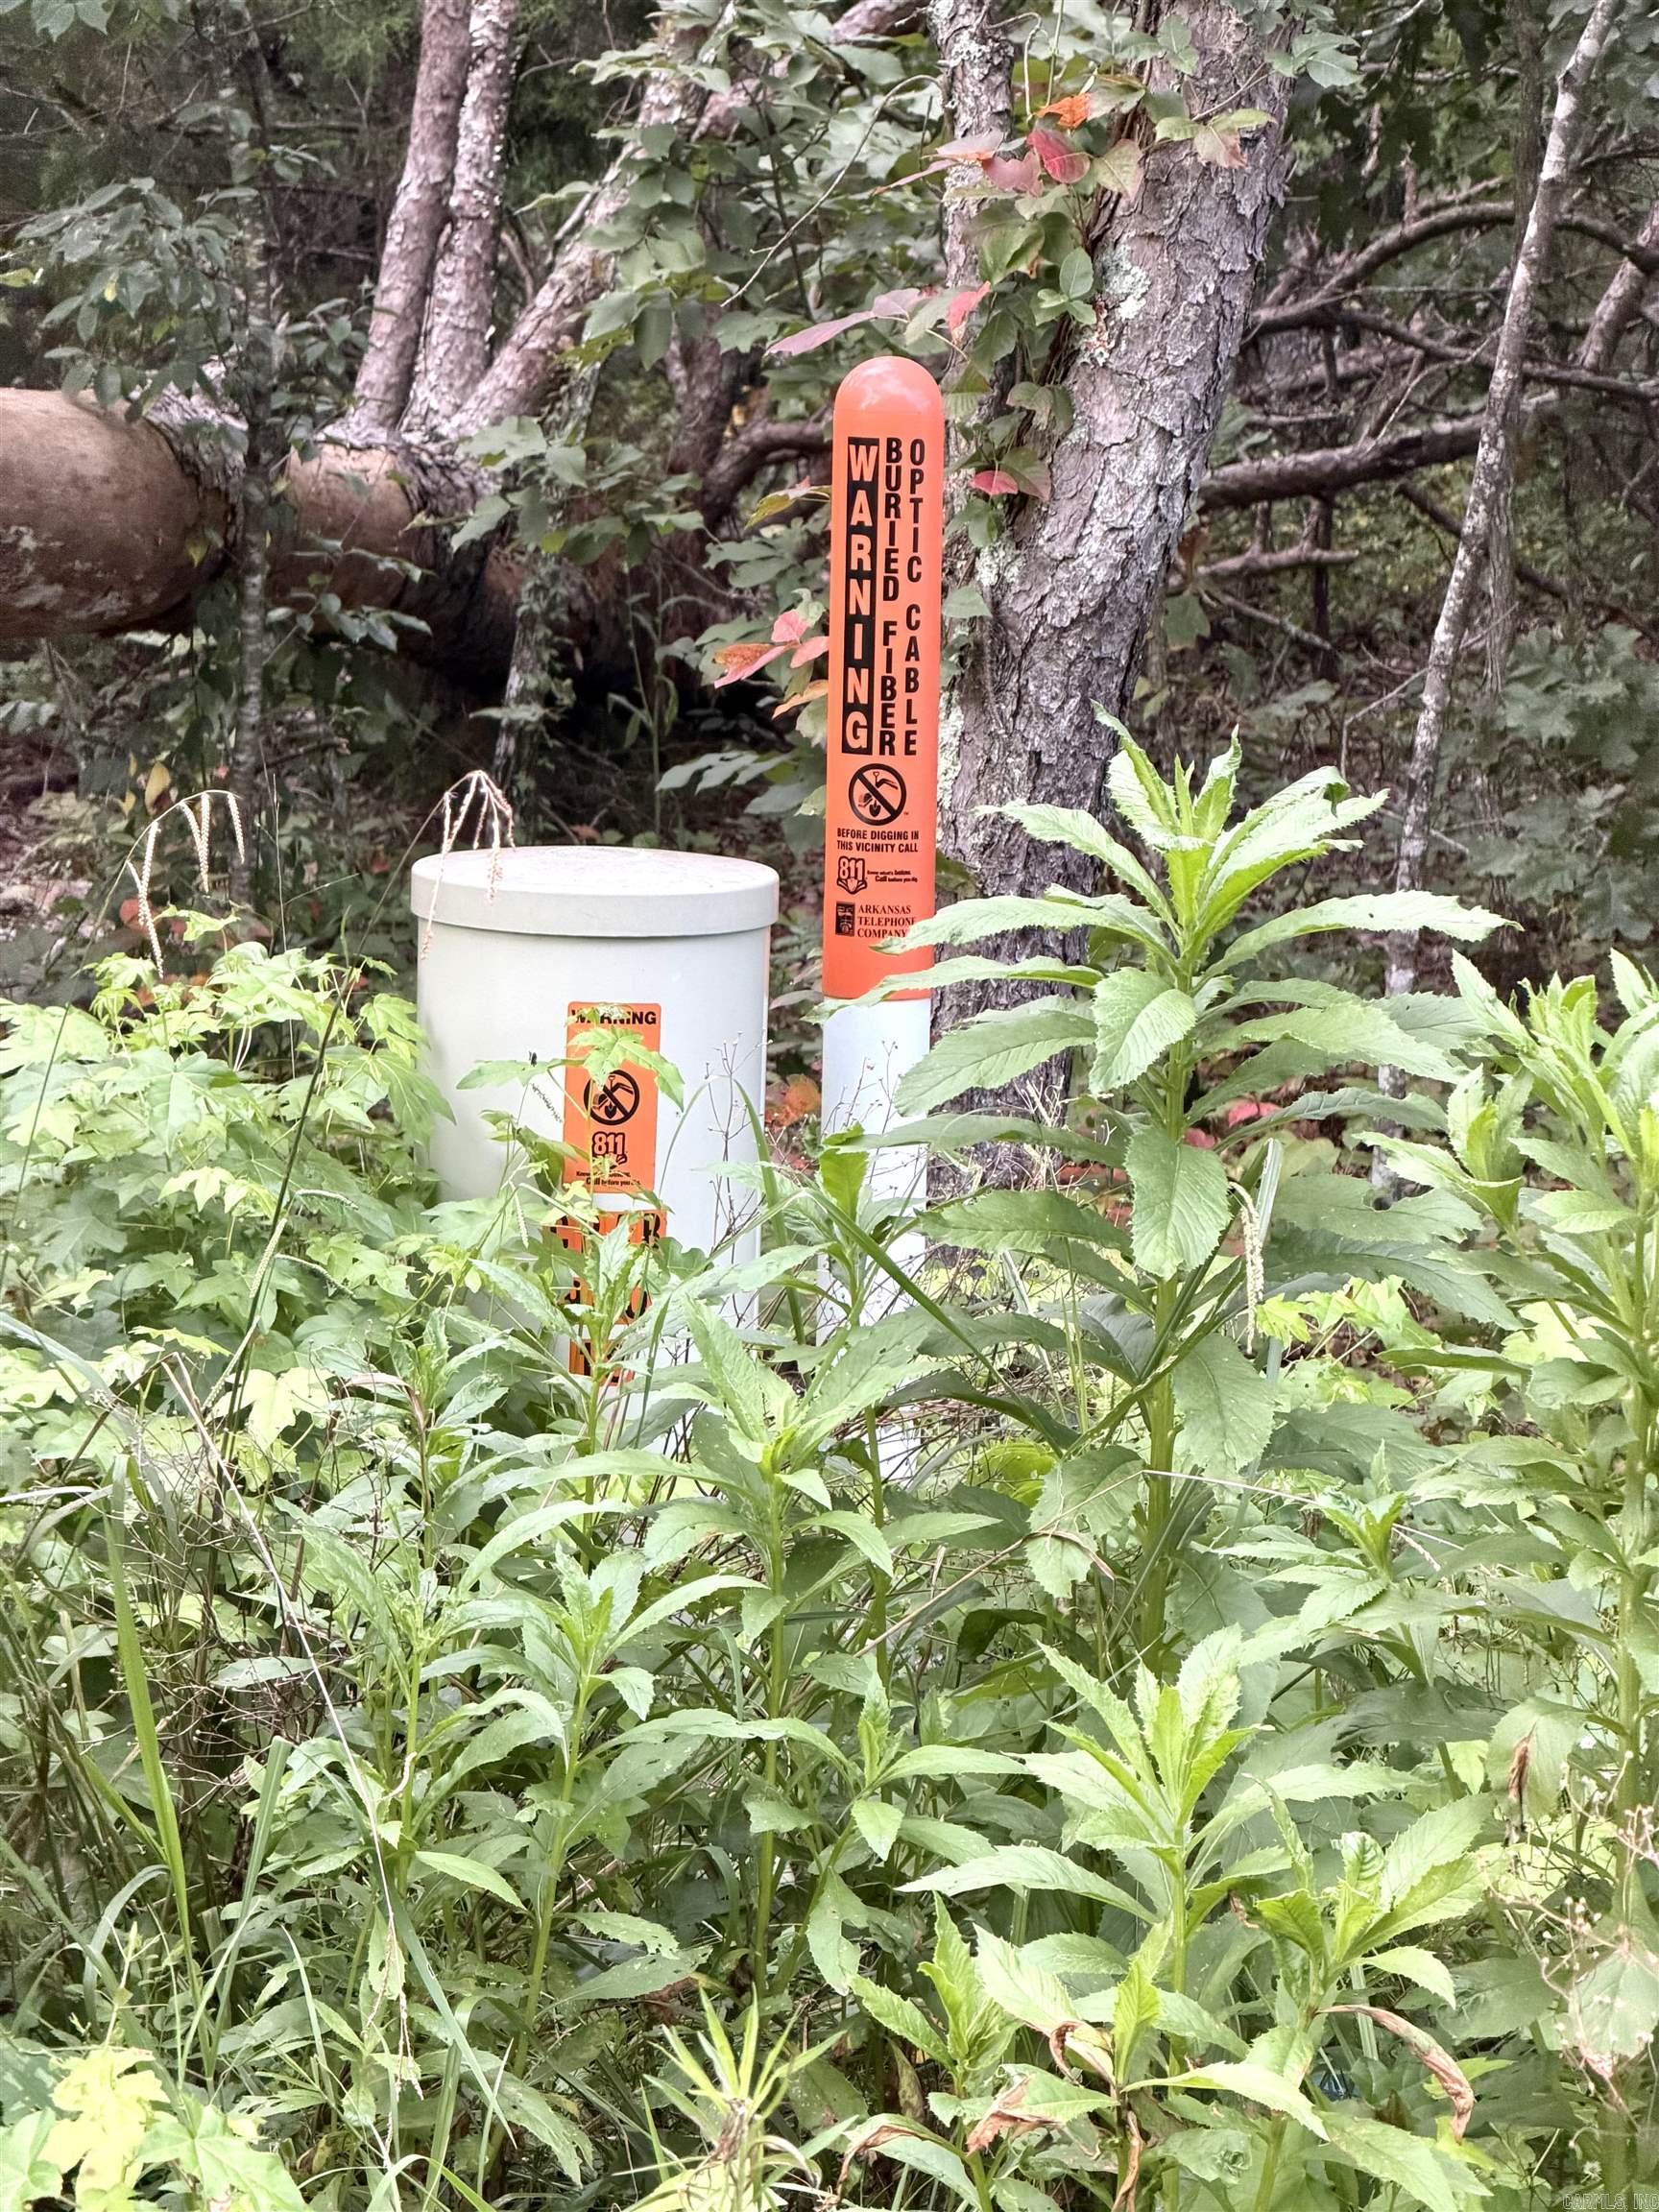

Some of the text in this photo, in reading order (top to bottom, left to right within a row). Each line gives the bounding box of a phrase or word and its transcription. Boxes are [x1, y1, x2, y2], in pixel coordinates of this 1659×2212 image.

[846, 444, 878, 749] WARNING
[878, 437, 902, 756] BURIED FIBER
[904, 438, 926, 756] OPTIC CABLE
[837, 828, 919, 840] BEFORE DIGGING IN
[837, 840, 918, 853] THIS VICINITY CALL
[838, 855, 866, 880] 811
[858, 904, 911, 914] ARKANSAS
[592, 1131, 625, 1156] 811
